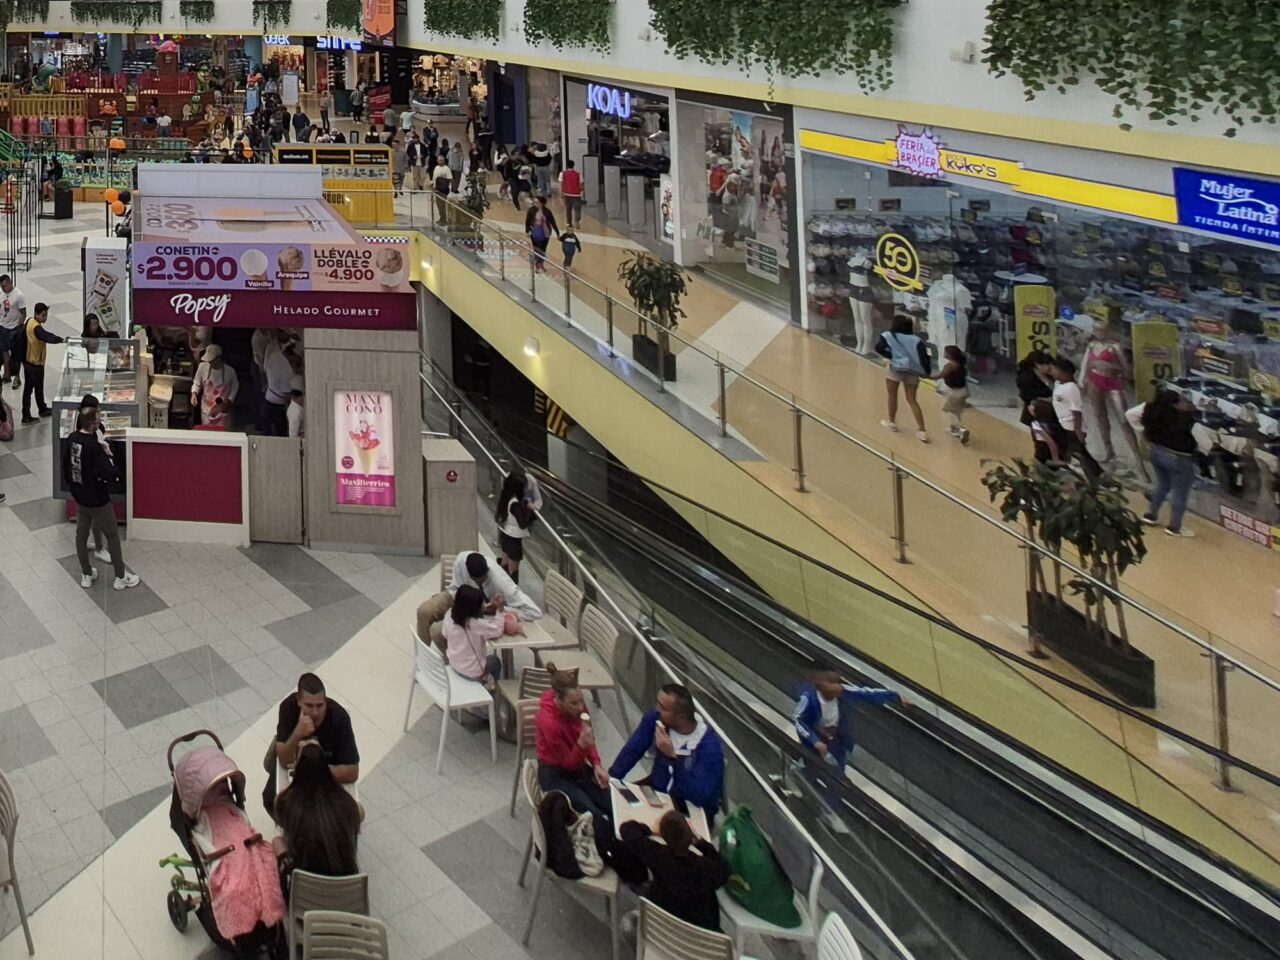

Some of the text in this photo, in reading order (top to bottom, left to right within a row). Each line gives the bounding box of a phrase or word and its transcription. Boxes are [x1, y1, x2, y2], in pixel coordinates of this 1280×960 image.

[587, 83, 631, 119] KOAJ
[900, 138, 926, 153] FERIA
[1200, 178, 1255, 200] Mujer
[1216, 202, 1279, 226] Latina
[1193, 215, 1239, 231] TIENDA
[155, 246, 211, 256] CONETIN
[314, 246, 373, 259] LLÉVALO
[883, 240, 913, 273] 50
[317, 259, 359, 269] DOBLE
[277, 271, 309, 281] Arequipe
[170, 293, 381, 323] Popsy HELADO GOURMET
